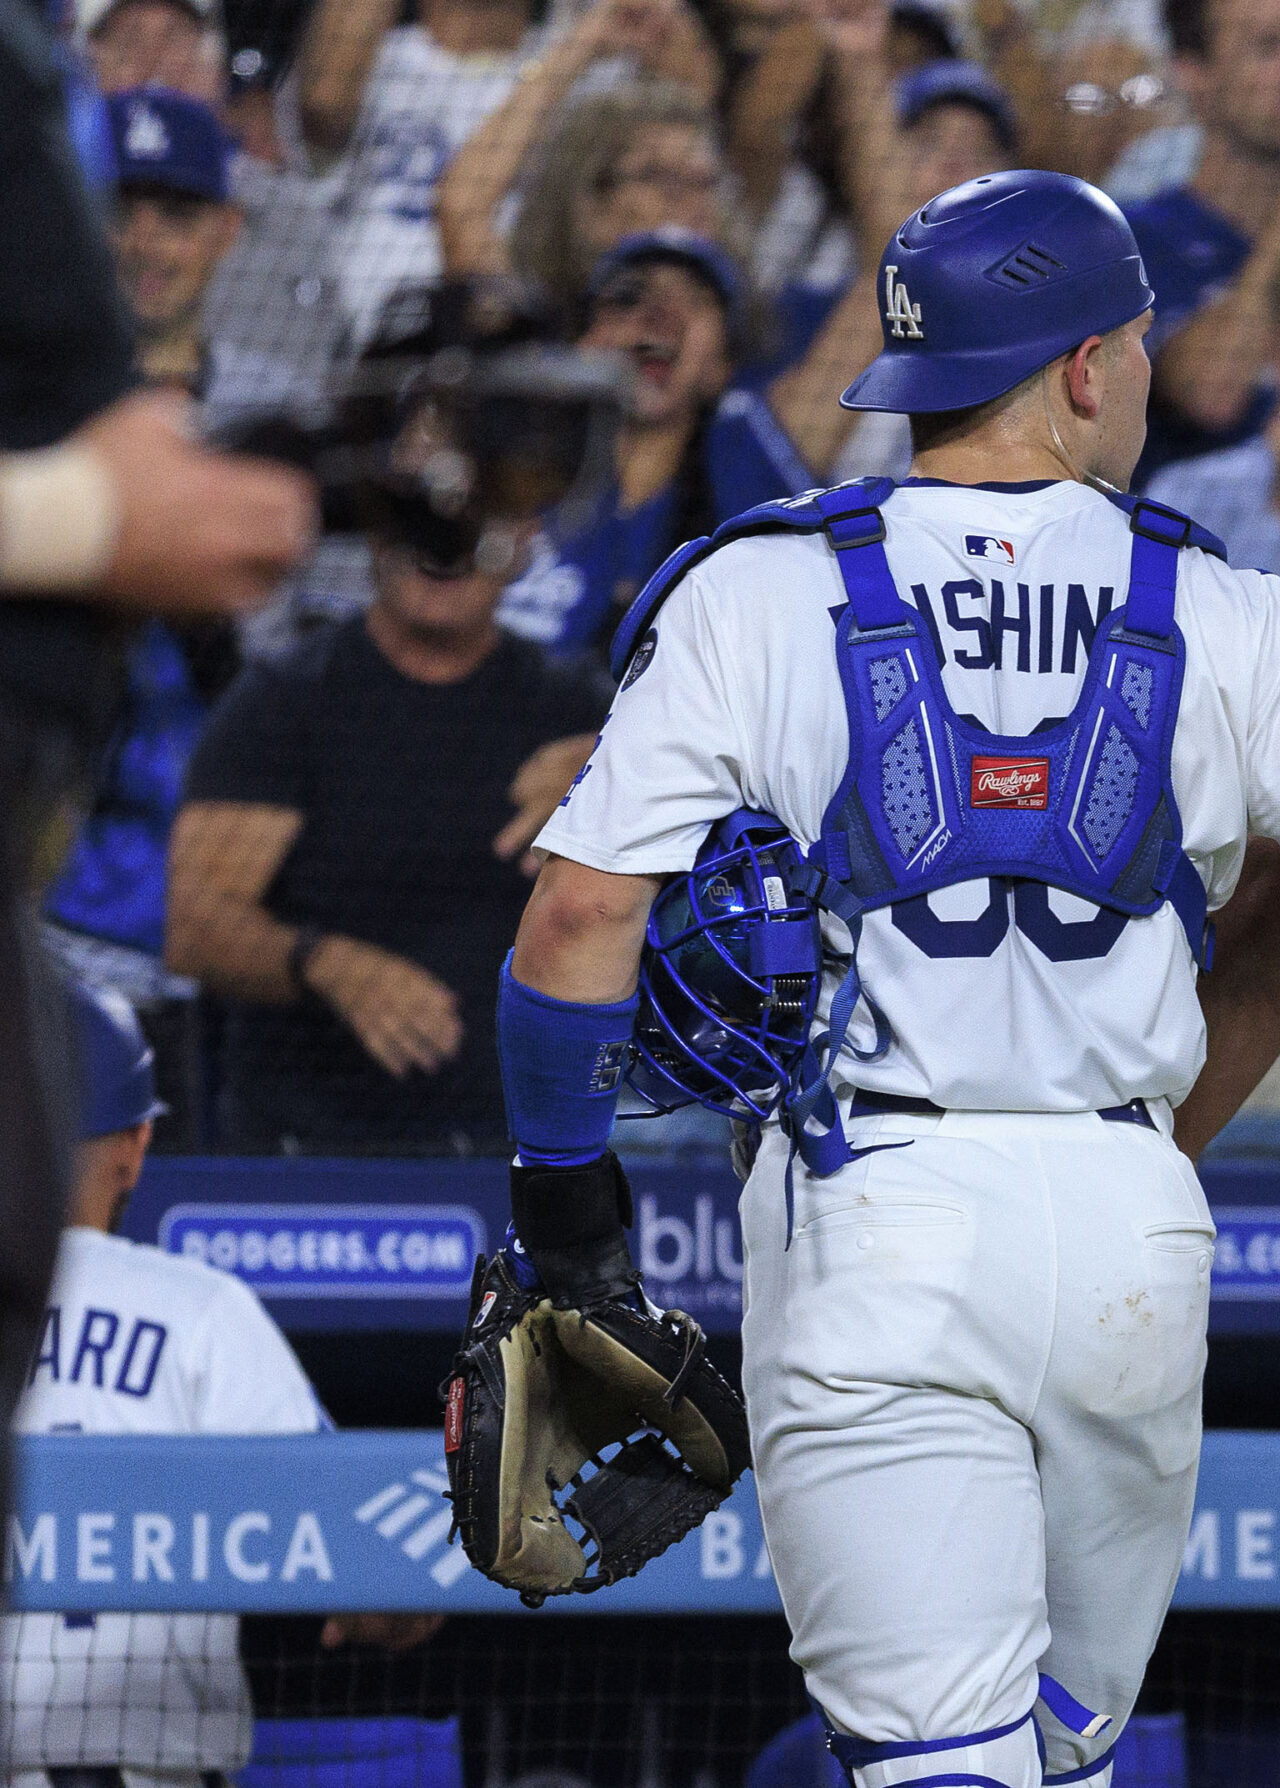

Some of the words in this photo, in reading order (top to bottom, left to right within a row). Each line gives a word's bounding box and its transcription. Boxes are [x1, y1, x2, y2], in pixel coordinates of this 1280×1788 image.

[885, 265, 924, 338] LA
[978, 769, 1041, 791] Rawlings
[29, 1306, 167, 1397] ARD
